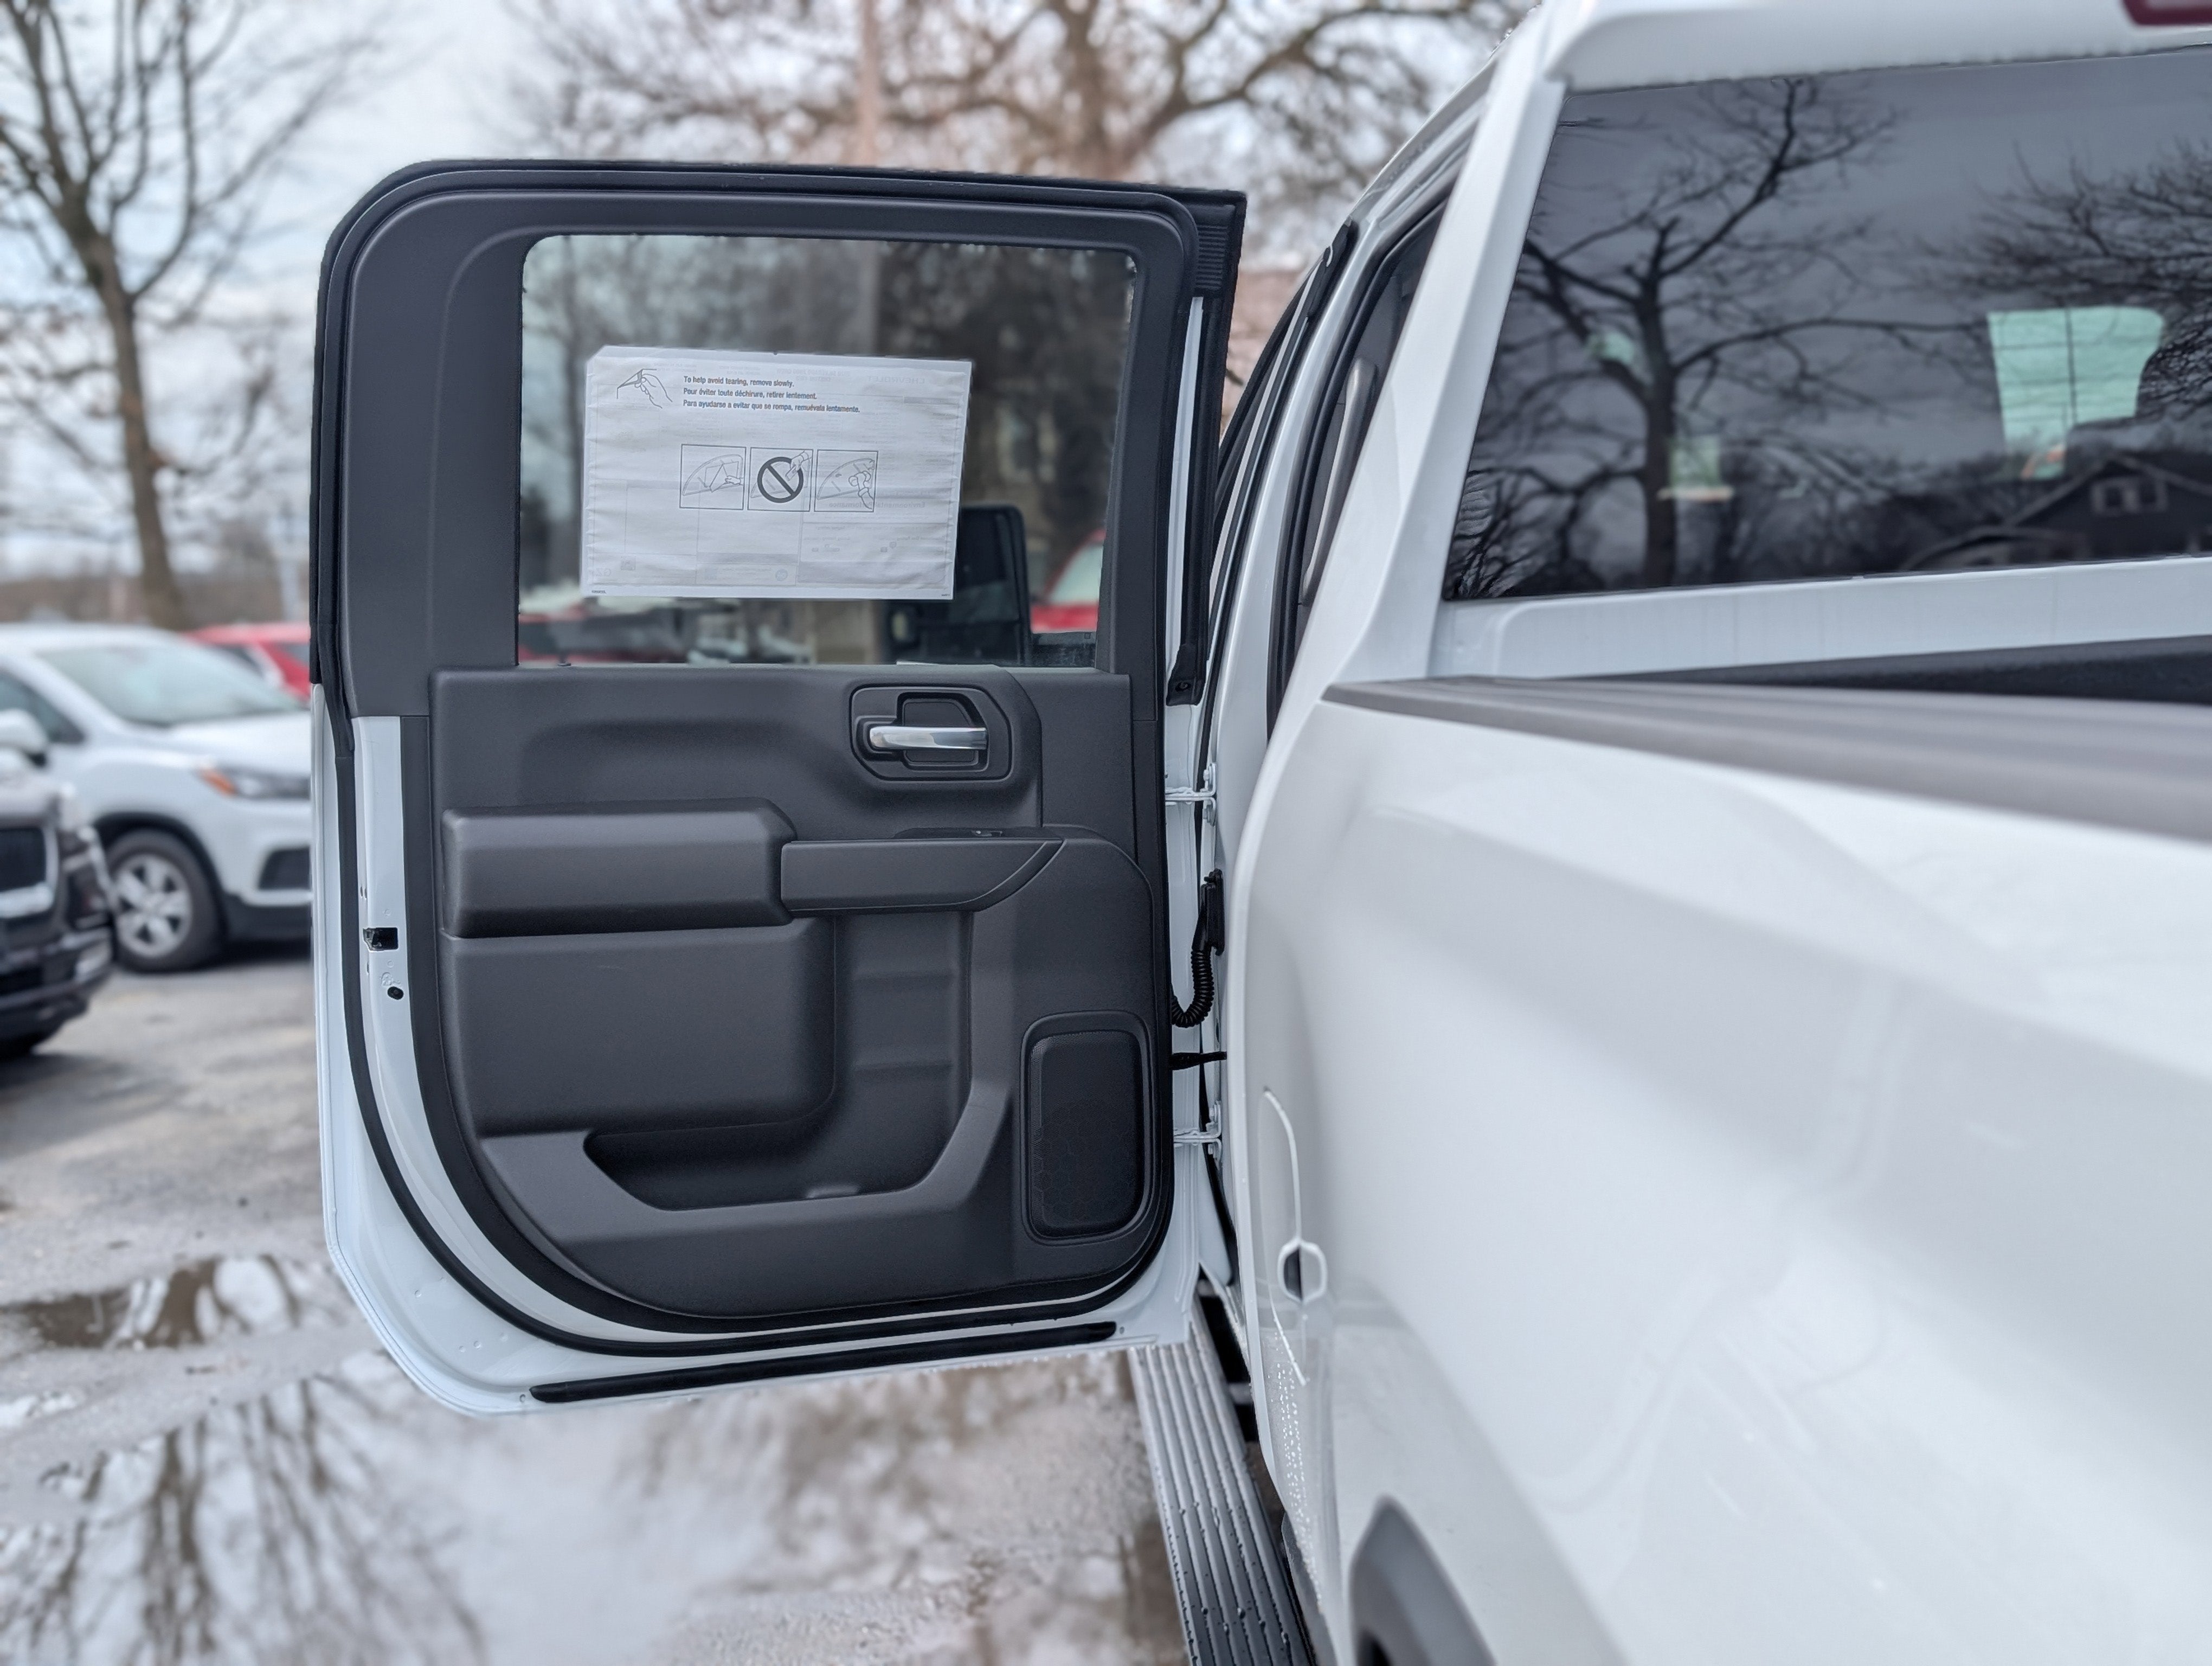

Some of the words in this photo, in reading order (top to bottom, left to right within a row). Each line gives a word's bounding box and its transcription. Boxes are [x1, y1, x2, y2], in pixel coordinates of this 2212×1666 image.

[692, 376, 706, 385] help
[707, 376, 724, 385] avoid
[725, 377, 749, 387] tearing,
[773, 379, 795, 388] slowly.
[699, 388, 717, 396] éviter
[735, 389, 765, 399] déchirure,
[786, 391, 818, 400] lentement.
[698, 400, 726, 409] ayudarse
[794, 403, 825, 412] remuévala
[826, 405, 860, 413] lentamente.
